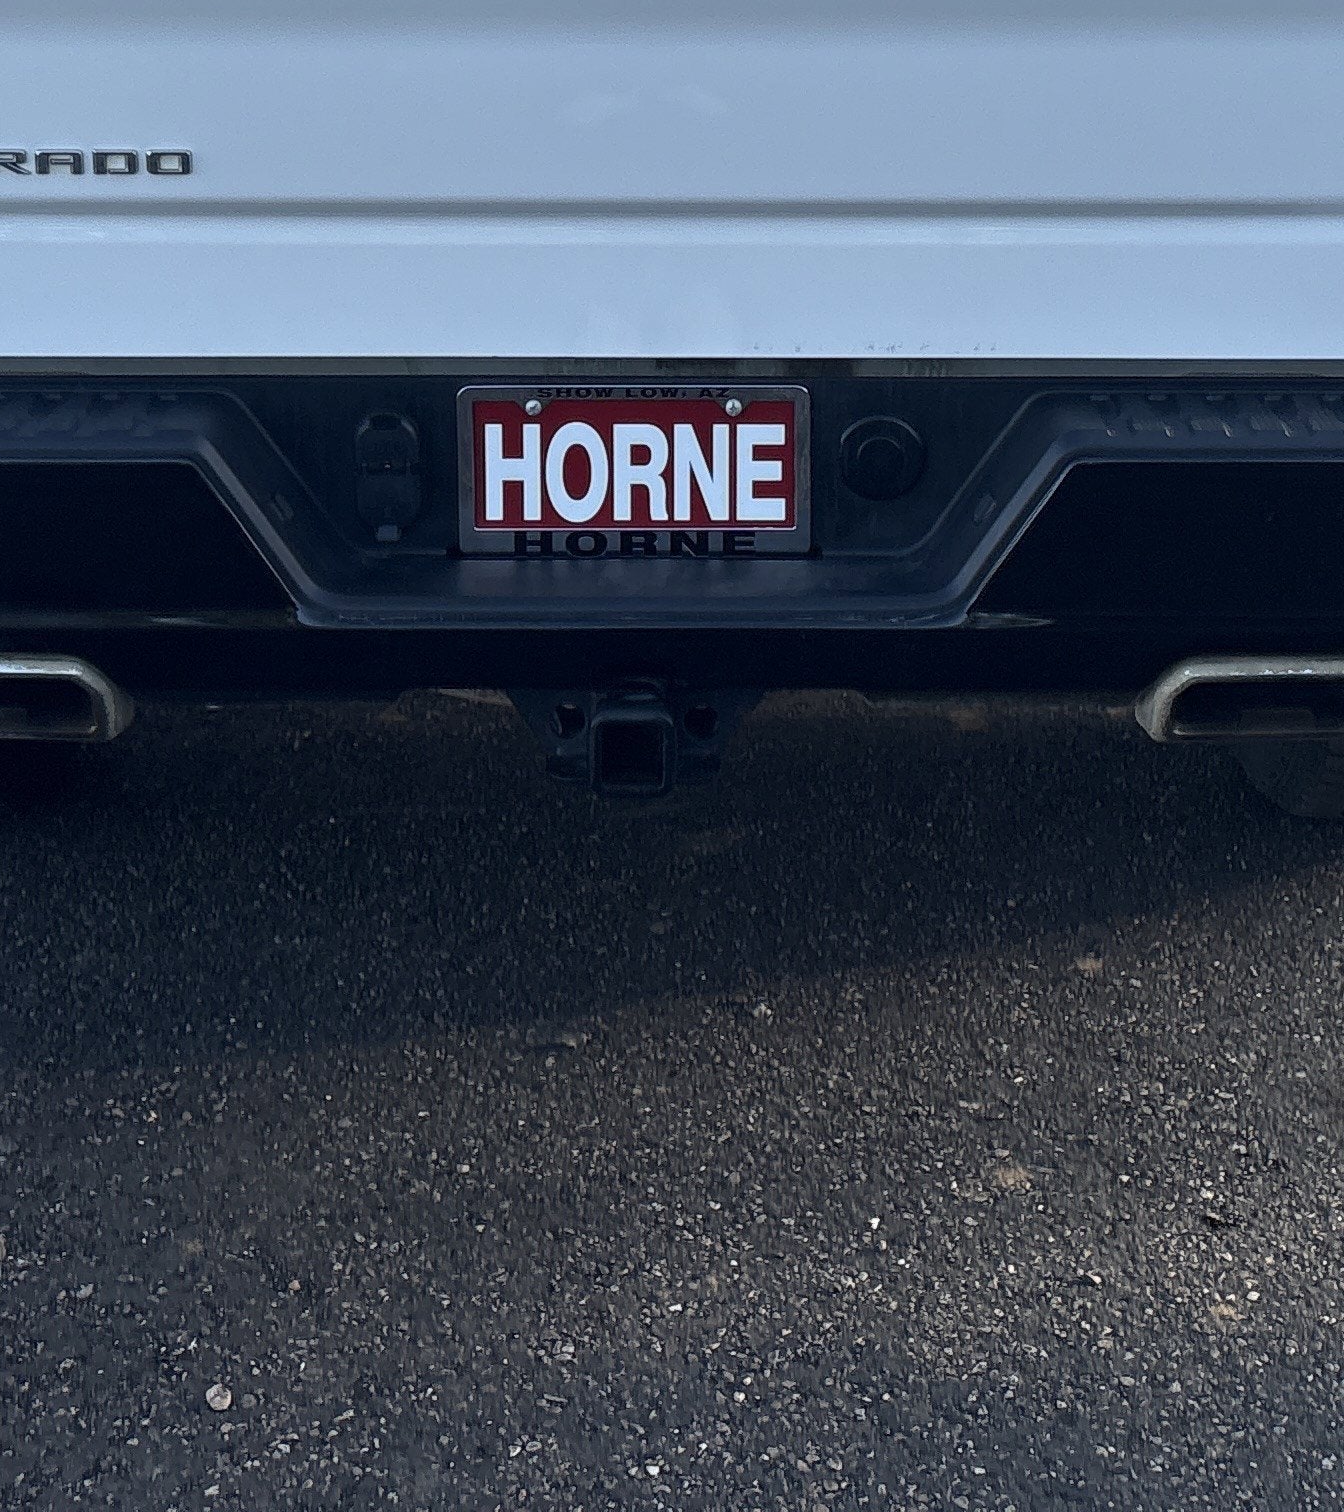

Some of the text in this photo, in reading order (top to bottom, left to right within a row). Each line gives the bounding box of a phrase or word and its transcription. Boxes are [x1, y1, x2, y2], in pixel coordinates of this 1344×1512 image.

[537, 388, 615, 398] SHOW
[699, 388, 731, 398] AZ
[484, 421, 786, 523] HORNE
[513, 529, 757, 557] HORNE
